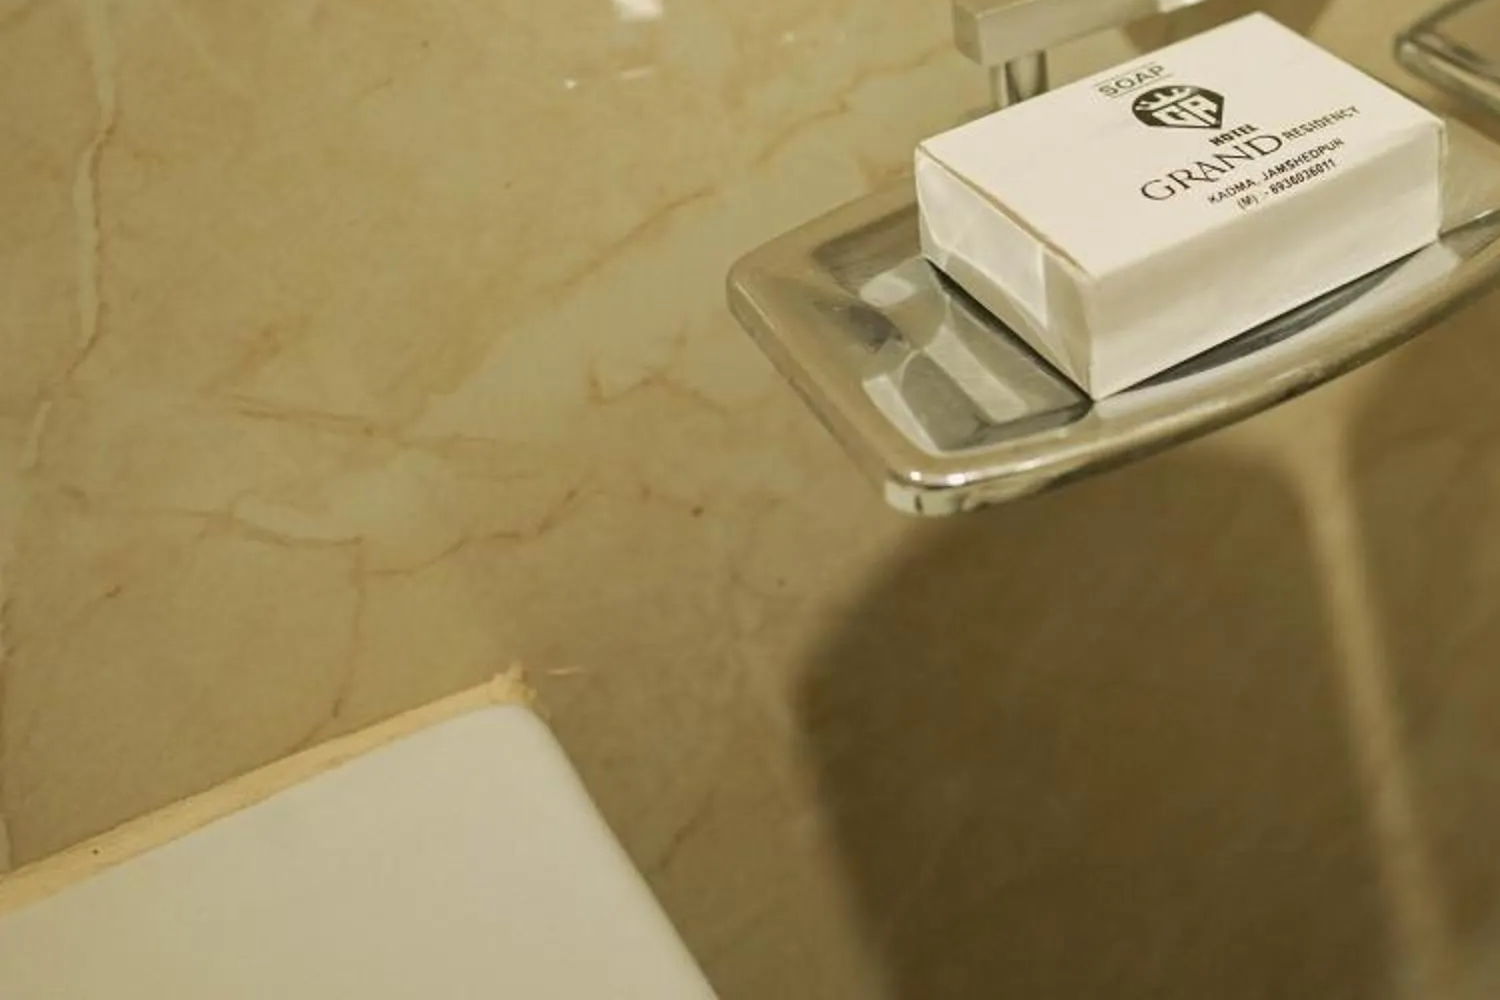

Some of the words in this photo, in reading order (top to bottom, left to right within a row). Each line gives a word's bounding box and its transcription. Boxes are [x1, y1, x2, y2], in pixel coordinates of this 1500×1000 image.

[1098, 64, 1165, 96] SOAP
[1208, 123, 1258, 147] HOTEL
[1140, 134, 1283, 201] GRAND
[1281, 105, 1361, 141] RESIDENCY
